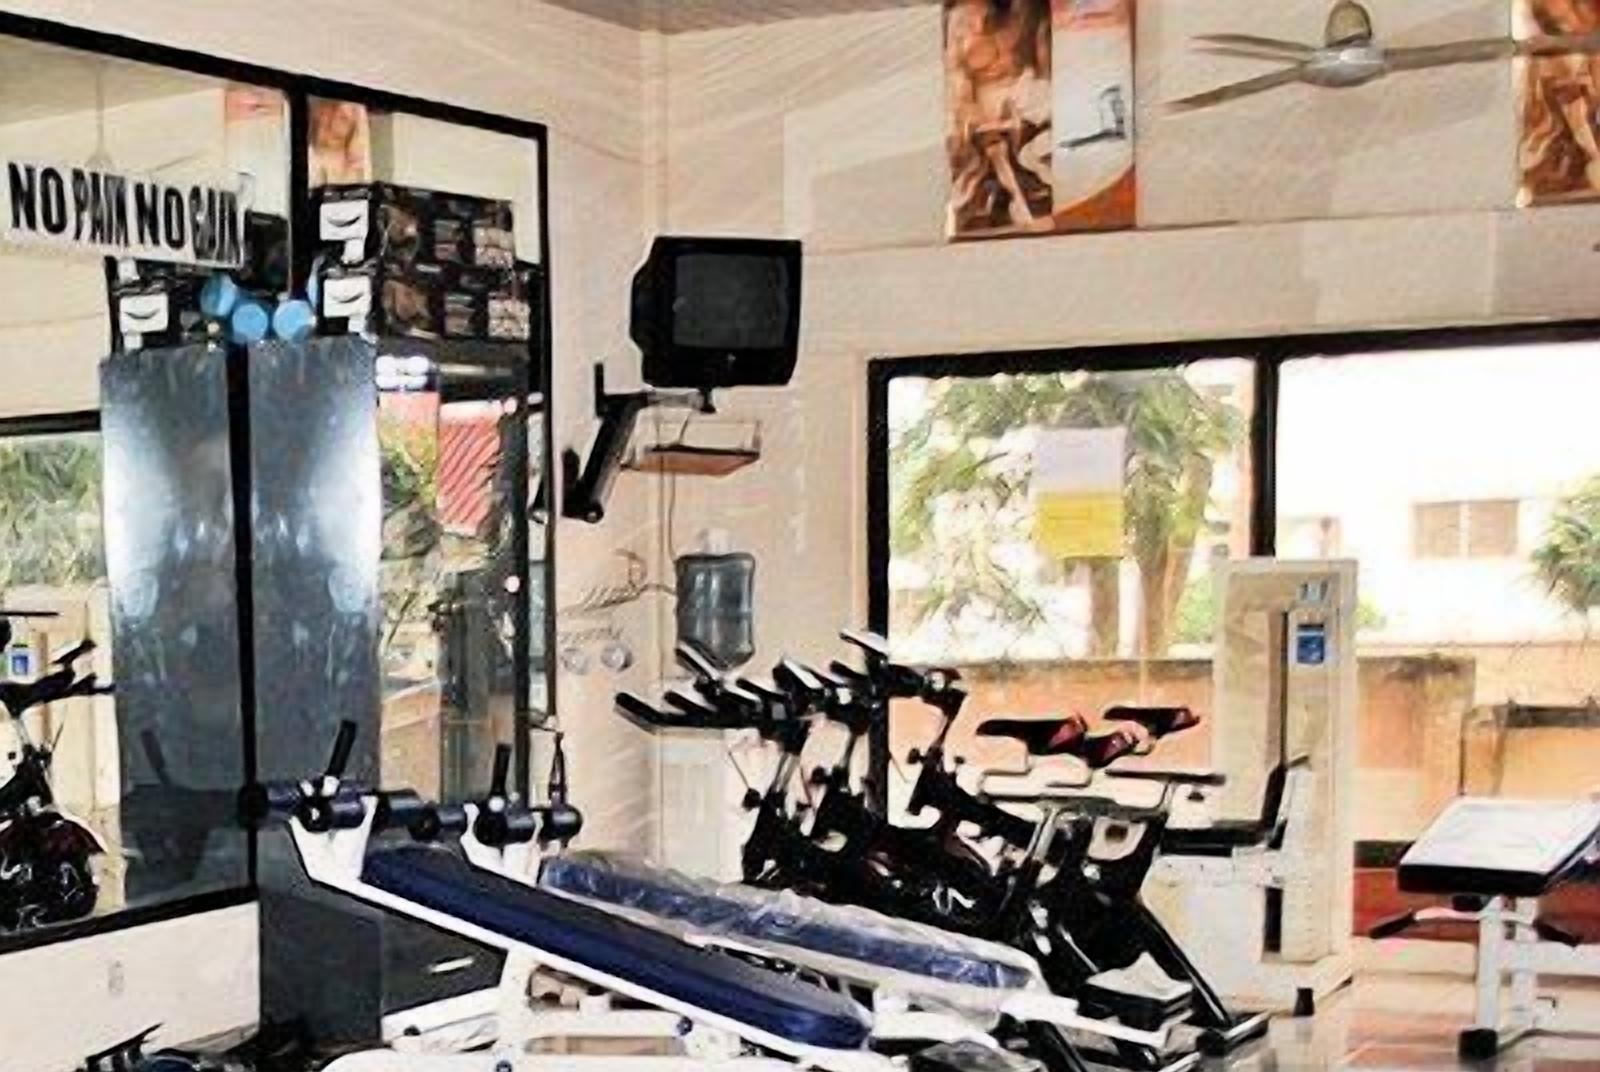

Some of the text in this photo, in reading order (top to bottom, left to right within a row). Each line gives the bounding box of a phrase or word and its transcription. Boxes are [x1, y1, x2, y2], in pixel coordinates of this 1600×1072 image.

[8, 162, 242, 266] NO PAIN NO GAIN
